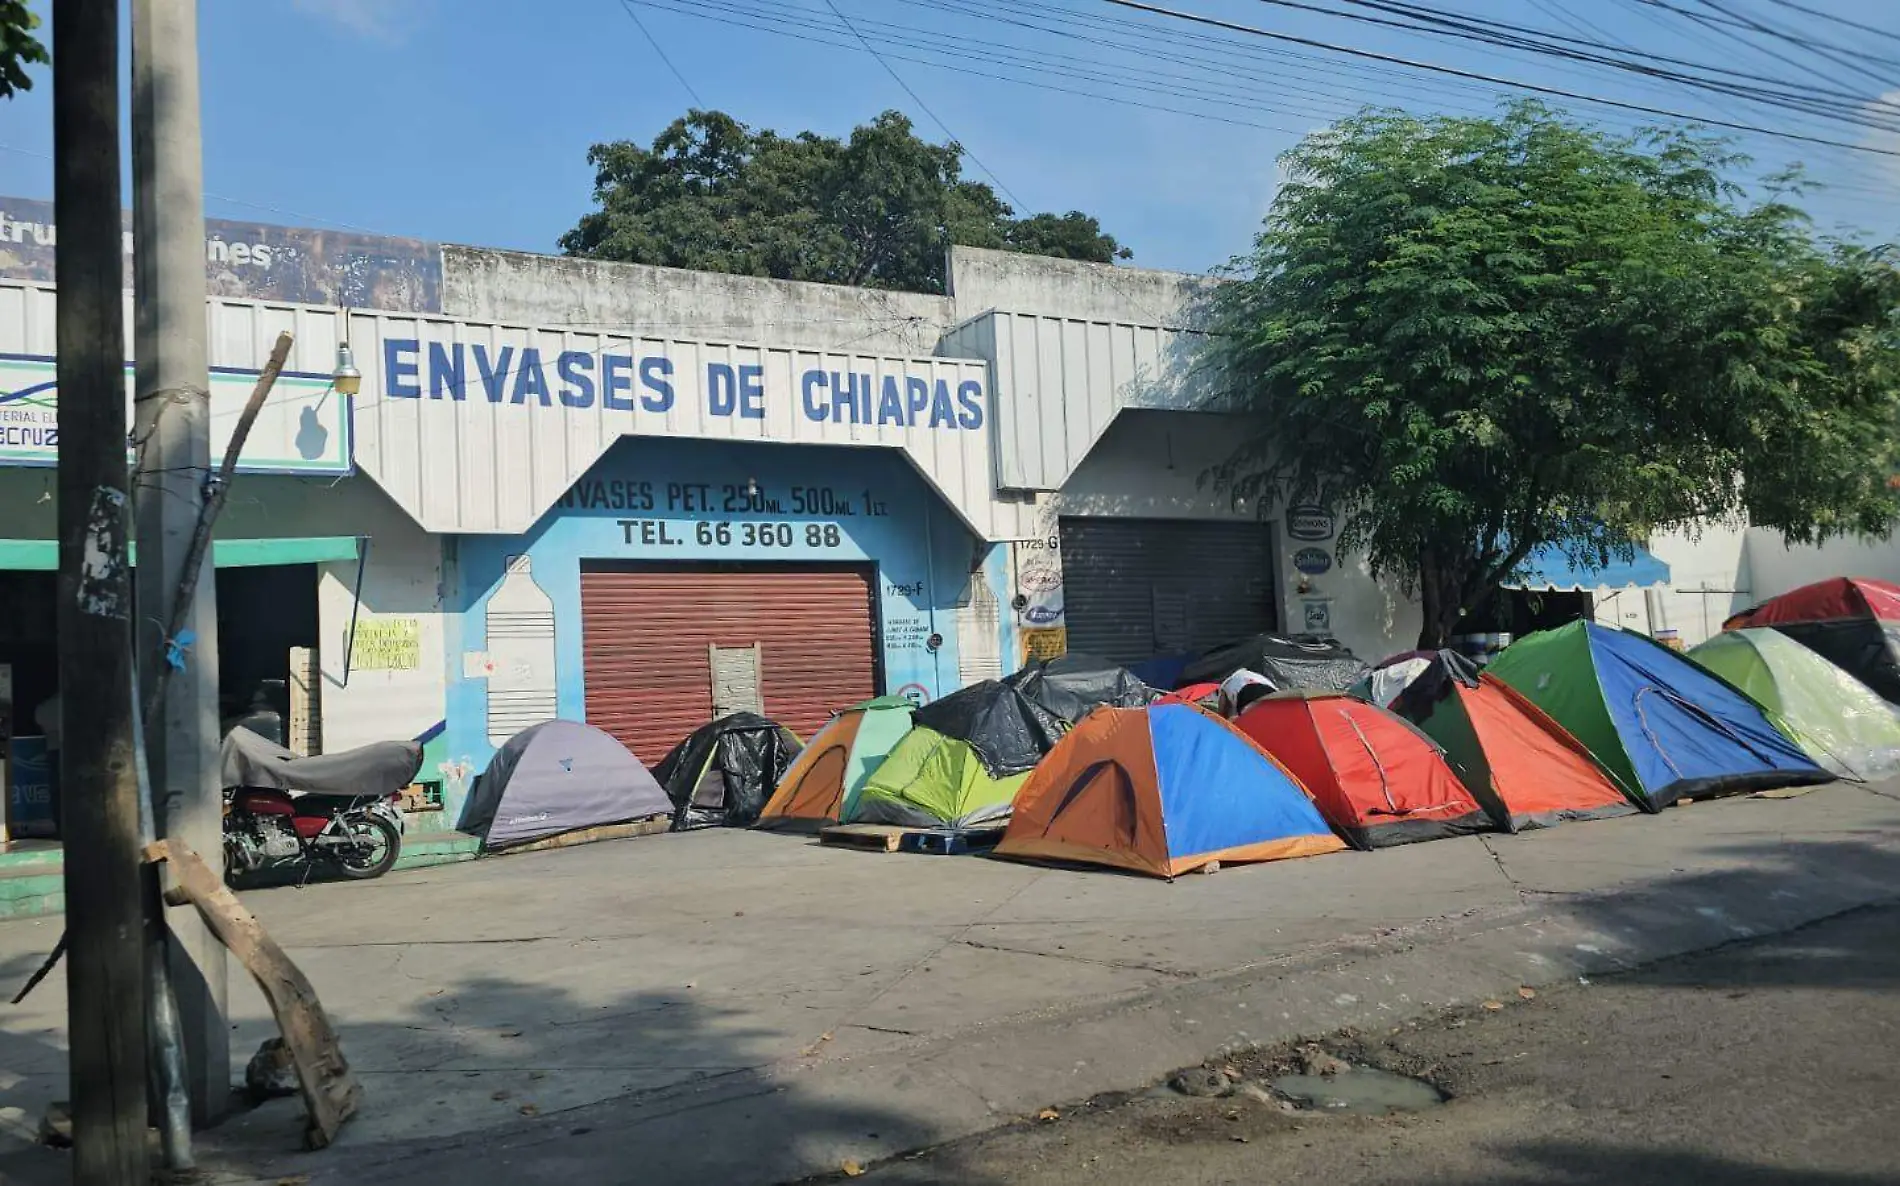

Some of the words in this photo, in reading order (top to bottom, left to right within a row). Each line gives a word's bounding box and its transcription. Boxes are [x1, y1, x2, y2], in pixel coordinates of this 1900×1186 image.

[384, 338, 675, 413] ENVASES
[707, 362, 766, 419] DE
[801, 369, 984, 431] CHIAPAS
[0, 410, 38, 423] ERIAL
[556, 479, 654, 511] NVASES
[668, 482, 716, 512] PET.
[616, 519, 684, 546] TEL.
[695, 521, 731, 546] 66
[741, 522, 793, 548] 360
[804, 523, 841, 548] 88
[1020, 536, 1058, 549] 1729-G
